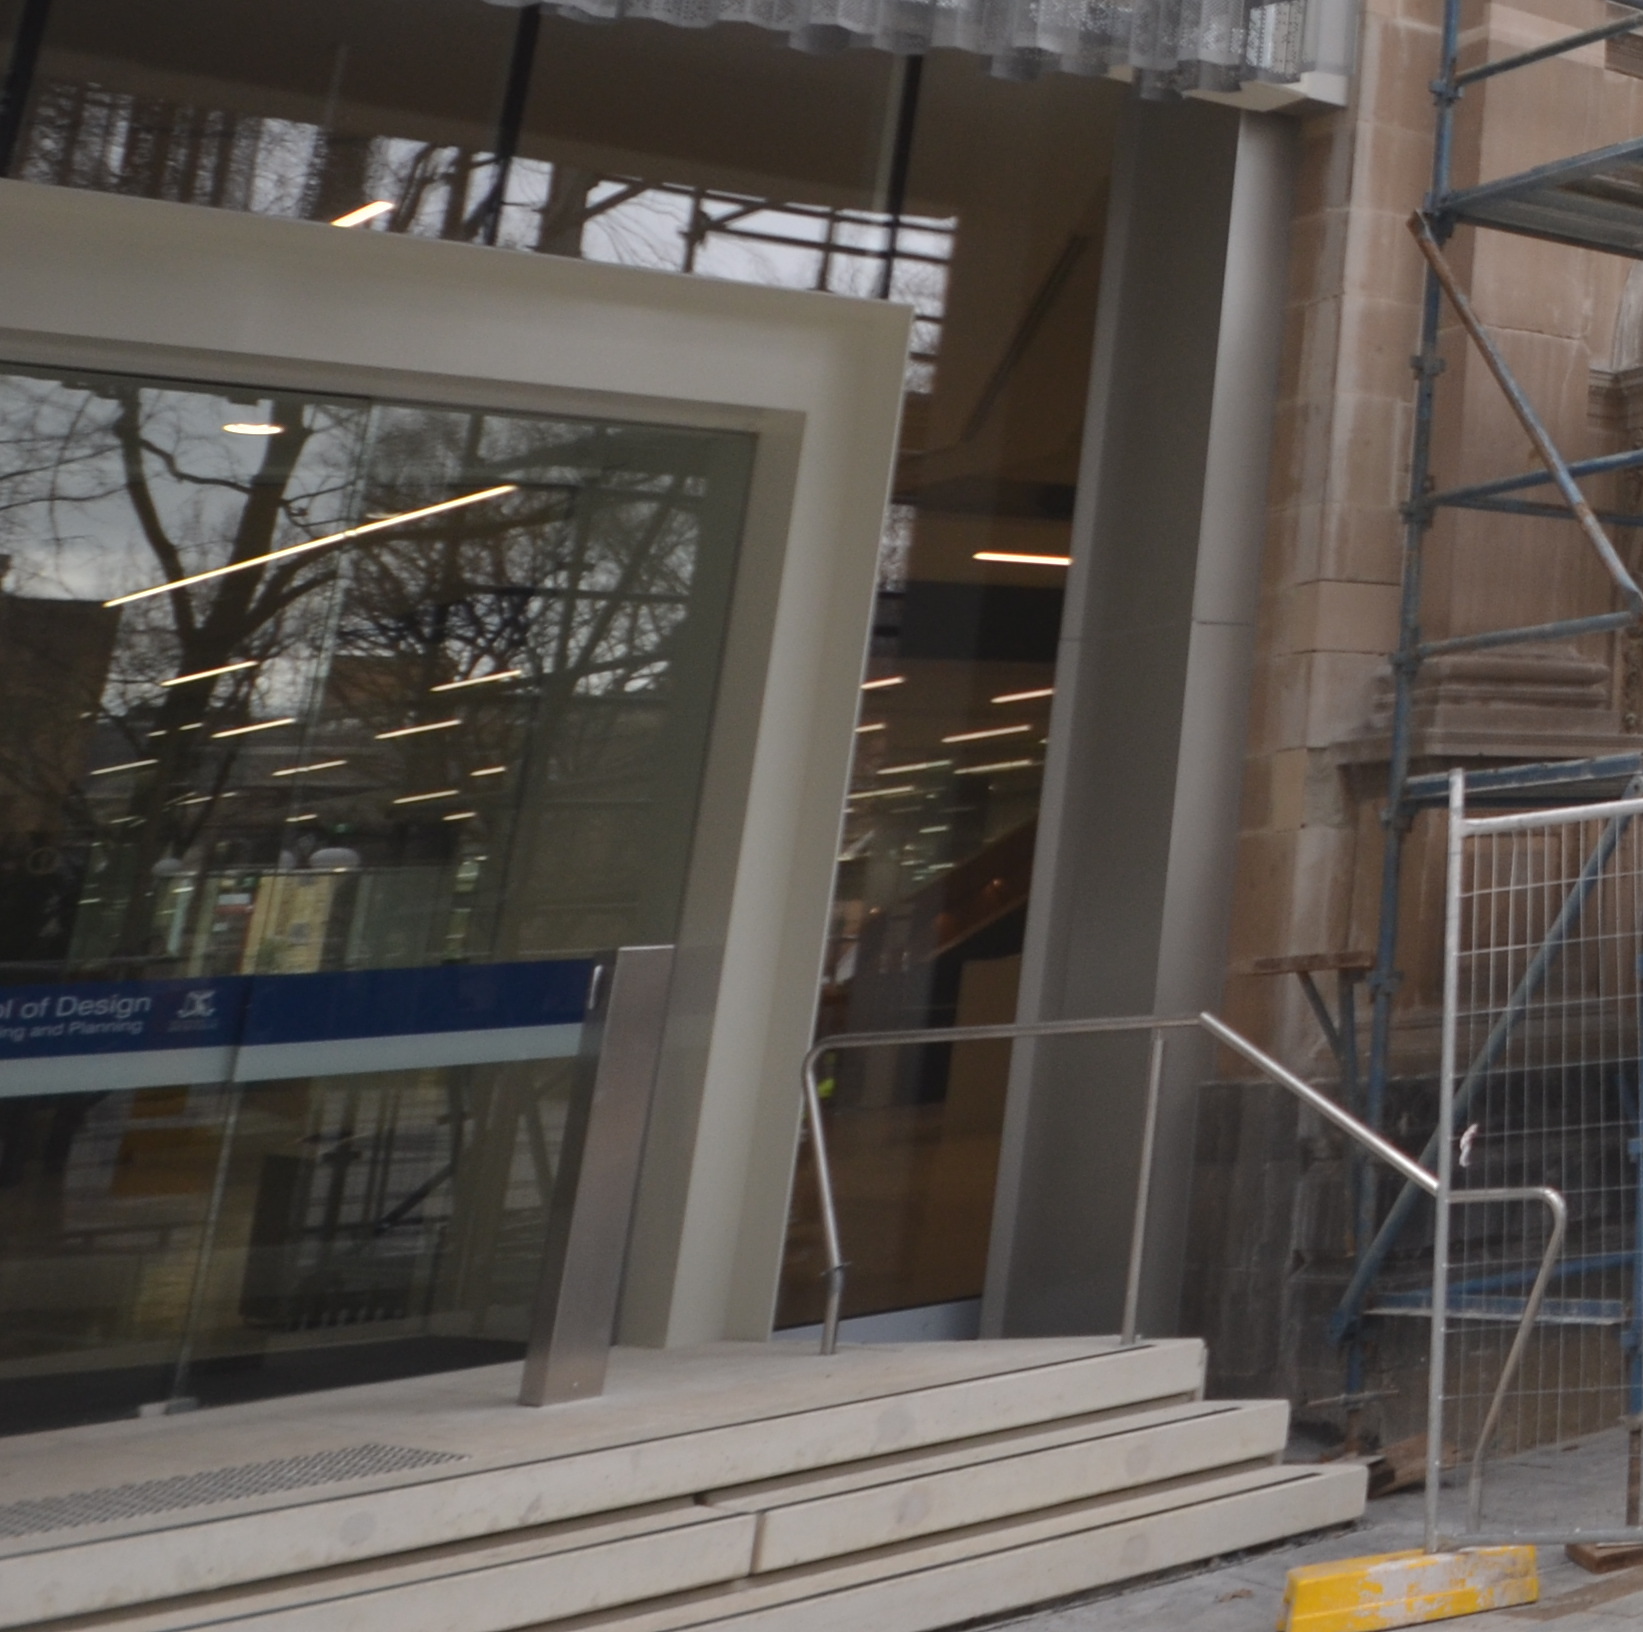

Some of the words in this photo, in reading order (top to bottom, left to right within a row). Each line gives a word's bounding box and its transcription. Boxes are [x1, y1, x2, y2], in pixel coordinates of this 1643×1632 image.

[20, 996, 51, 1019] of
[55, 993, 153, 1019] Design
[30, 1022, 64, 1038] and
[67, 1019, 145, 1035] Planning
